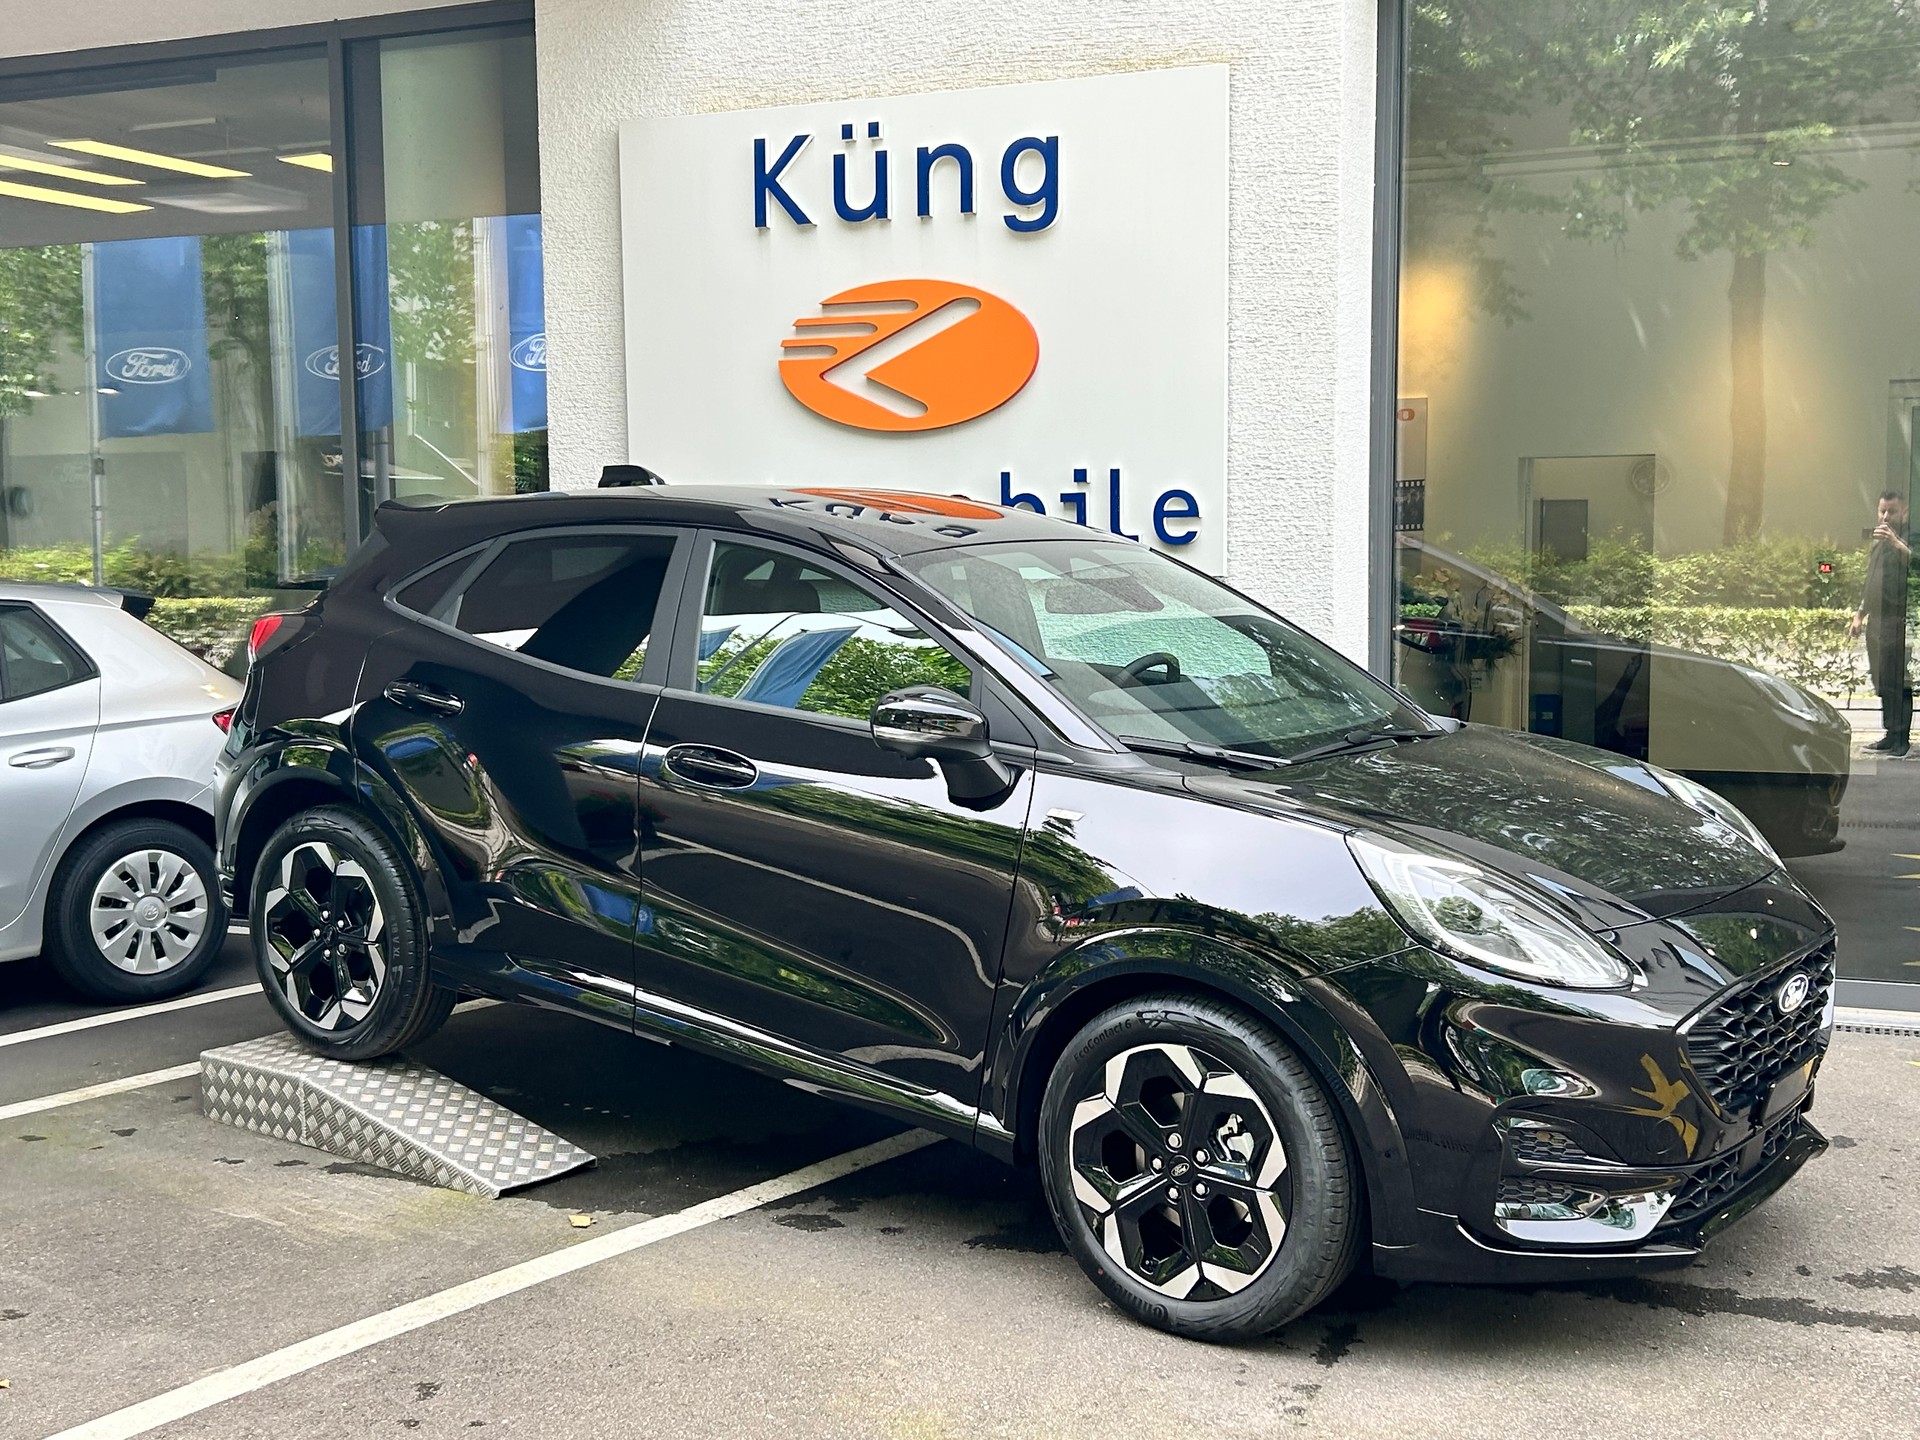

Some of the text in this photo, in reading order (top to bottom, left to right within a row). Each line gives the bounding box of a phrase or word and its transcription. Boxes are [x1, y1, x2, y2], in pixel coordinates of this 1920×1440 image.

[753, 121, 1060, 233] Küng
[121, 351, 180, 378] Ford
[1073, 1018, 1133, 1063] EcoContact 6
